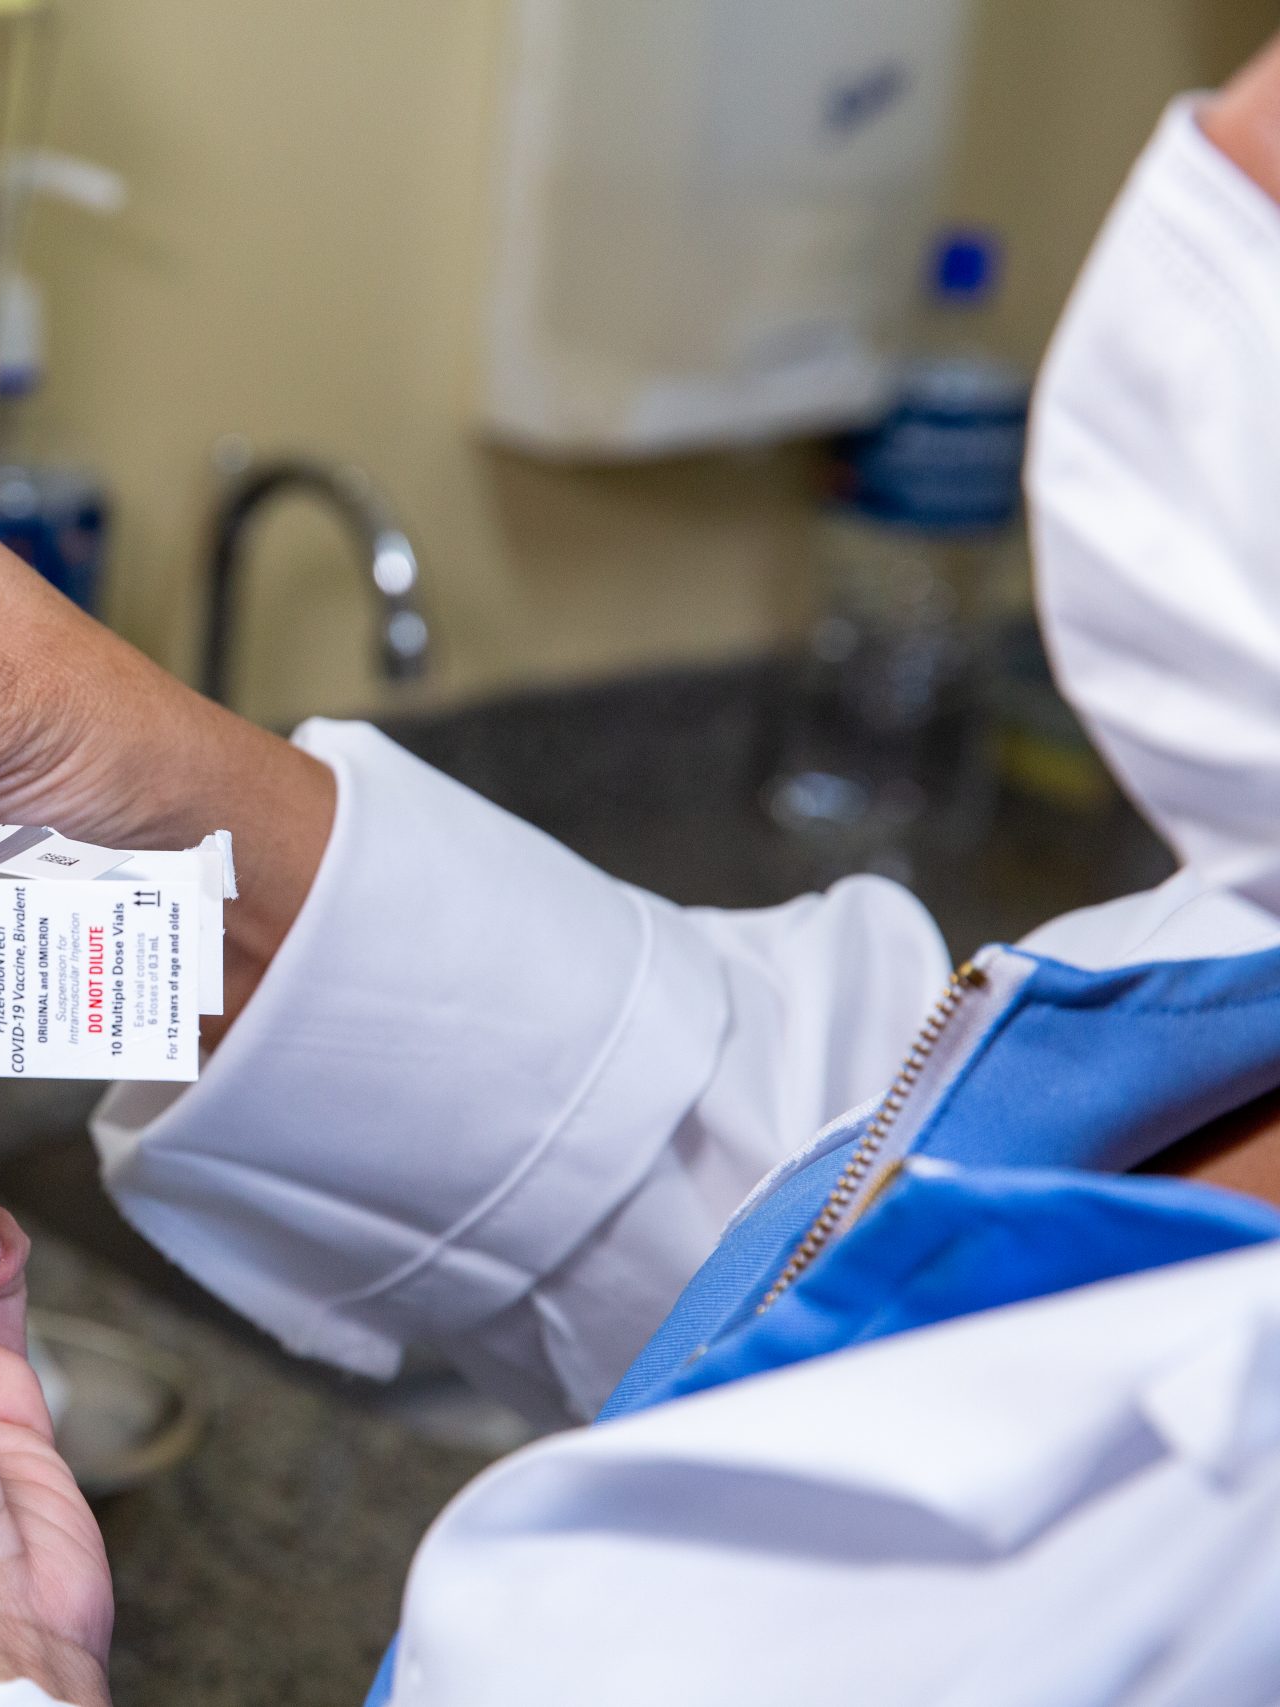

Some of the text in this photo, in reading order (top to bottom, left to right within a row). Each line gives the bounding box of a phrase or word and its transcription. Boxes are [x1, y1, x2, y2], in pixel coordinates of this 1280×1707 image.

[11, 886, 27, 1074] COVID-19 Vaccine, Bivalent
[38, 917, 49, 1044] ORIGINAL and OMICRON
[55, 934, 68, 1023] Suspension for
[68, 912, 82, 1045] Intramuscular Injection
[88, 926, 104, 1034] DO NOT DILUTE
[111, 902, 126, 1056] 10 Multiple Dose Vials
[134, 932, 145, 1028] Each vial contains
[148, 936, 159, 1026] 6 doses of 0.3 mL
[167, 902, 181, 1060] For 12 years of age and older
